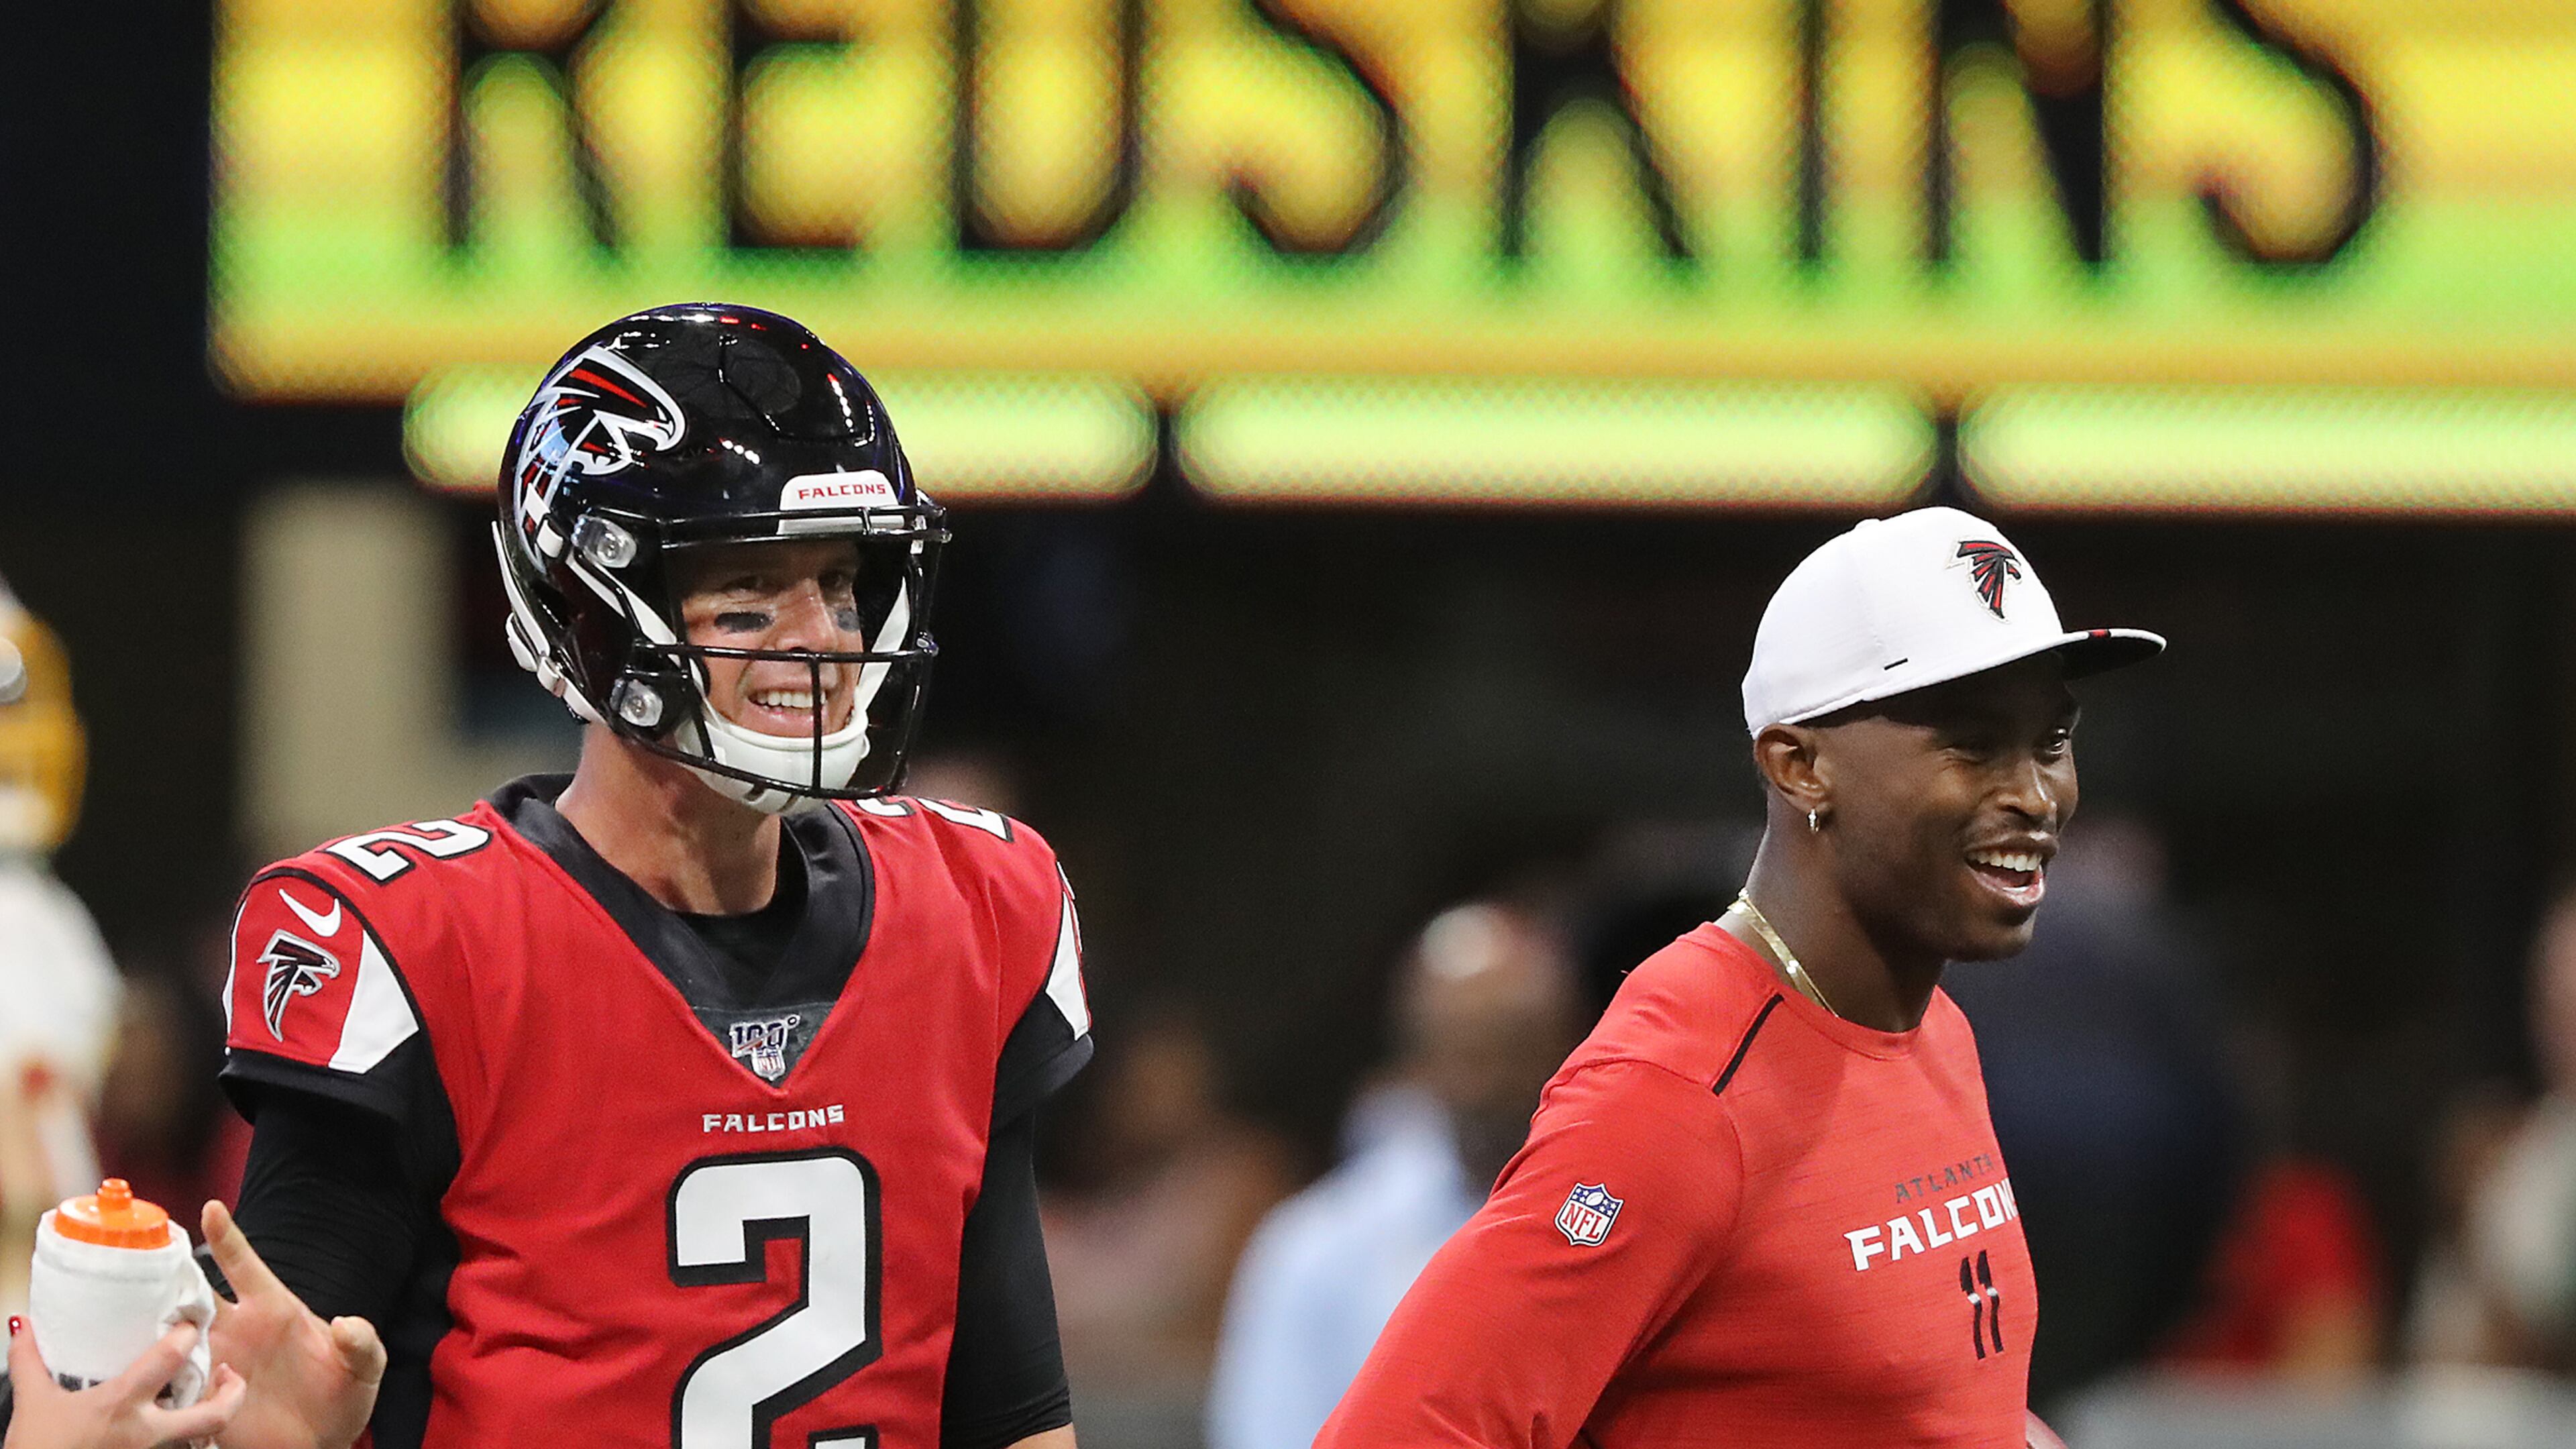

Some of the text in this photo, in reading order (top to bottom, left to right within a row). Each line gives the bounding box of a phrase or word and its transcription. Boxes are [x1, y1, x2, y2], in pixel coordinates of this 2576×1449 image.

[798, 484, 886, 500] FALCONS
[315, 818, 494, 887] 2
[702, 1104, 845, 1132] FALCONS
[1562, 1203, 1603, 1239] NFL
[664, 1145, 883, 1449] 2
[1960, 1249, 2004, 1360] 11
